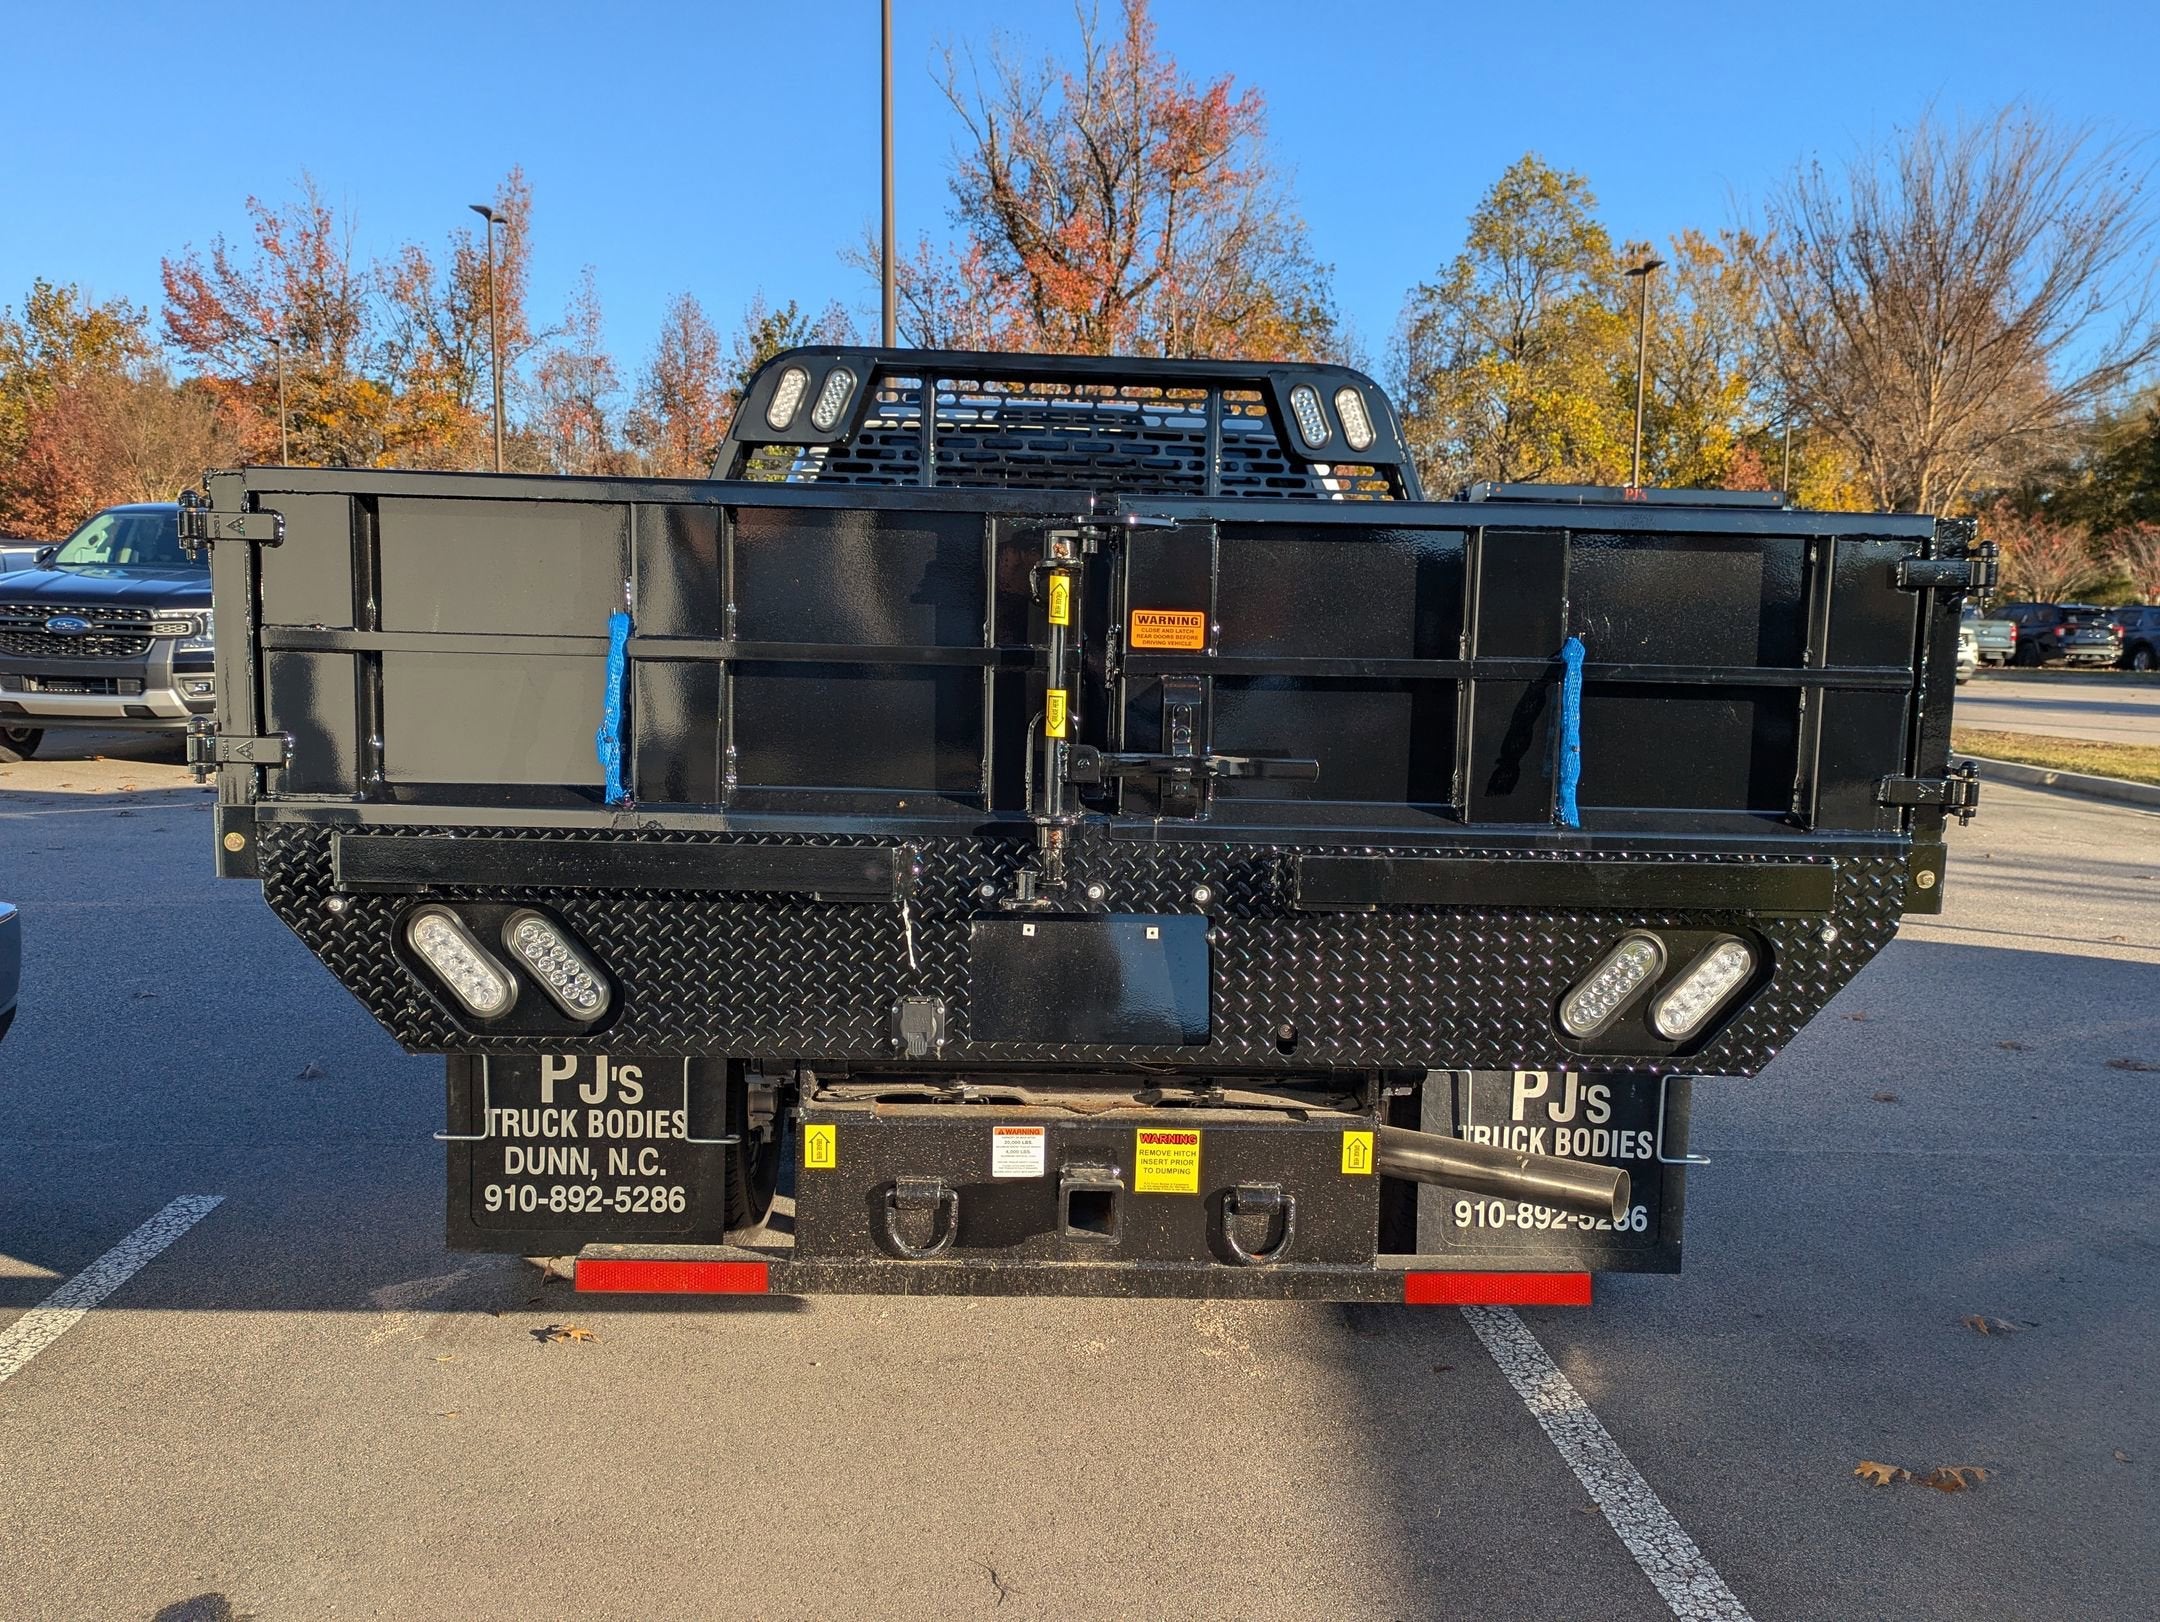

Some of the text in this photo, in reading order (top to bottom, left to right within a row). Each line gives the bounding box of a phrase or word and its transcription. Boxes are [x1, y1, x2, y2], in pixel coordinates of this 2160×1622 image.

[1137, 615, 1199, 626] WARNING
[484, 1108, 685, 1139] TRUCK BODIES
[1139, 1132, 1198, 1145] WARNING
[1555, 1127, 1653, 1160] BODIES
[1139, 1149, 1172, 1157] REMOVE
[505, 1146, 667, 1181] DUNN, N.C.
[1140, 1158, 1168, 1166] INSERT
[1155, 1167, 1191, 1175] DUMPING
[484, 1184, 686, 1213] 910-892-5286
